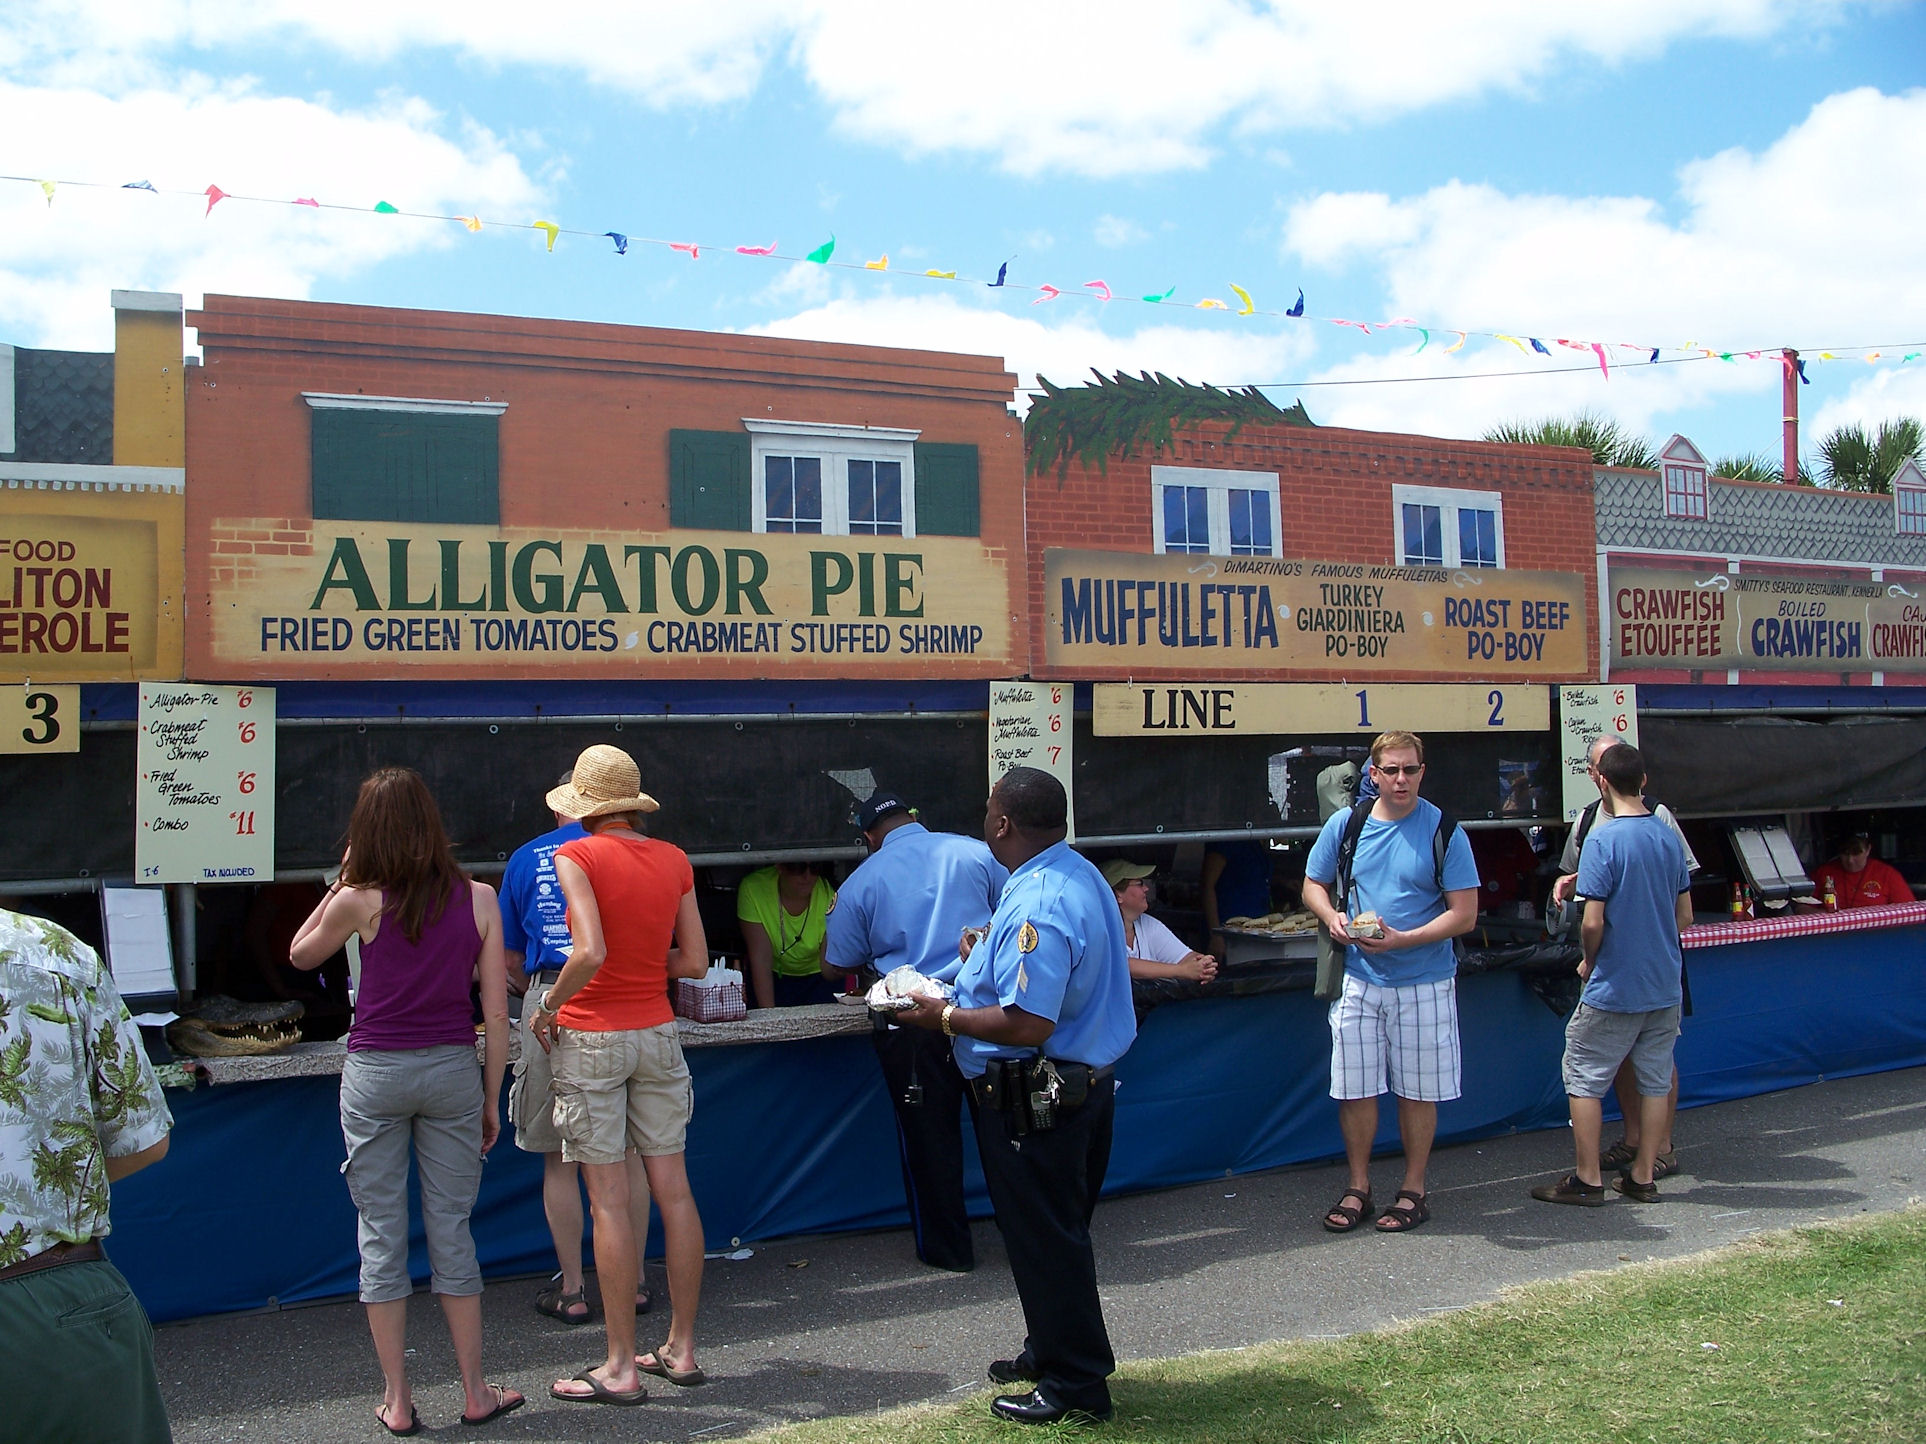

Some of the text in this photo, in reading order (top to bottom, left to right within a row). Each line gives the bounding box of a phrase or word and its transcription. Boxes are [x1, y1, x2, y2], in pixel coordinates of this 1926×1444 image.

[308, 537, 924, 618] ALLIGATOR PIE
[1311, 564, 1363, 579] FAMOUS
[1368, 567, 1448, 583] MUFFULETTAS
[1320, 583, 1384, 608] TURKEY
[1771, 581, 1805, 594] SEAFOOD
[1061, 577, 1279, 649] MUFFULETTA
[1444, 597, 1570, 630] ROAST BEEF
[1616, 588, 1725, 621] CRAWFISH
[1778, 600, 1826, 617] BOILED
[0, 612, 130, 653] EROLE
[1296, 607, 1405, 634] GIARDINIERA
[261, 617, 983, 654] FRIED GREEN TOMATOES CRABMEAT STUFFED SHRIMP
[1325, 634, 1389, 658] PO-BOY
[1467, 631, 1545, 662] PO-BOY
[1751, 618, 1861, 658] CRAWFISH
[1873, 623, 1926, 657] CRAWFI
[200, 692, 219, 705] Pie
[1142, 689, 1505, 728] LINE 1 2
[22, 692, 60, 744] 3
[150, 719, 207, 735] Crabmeat
[156, 732, 199, 748] Stuffed
[167, 746, 209, 762] Shrimp
[994, 748, 1014, 760] Roast
[150, 768, 177, 783] Fried
[158, 780, 194, 796] Green
[168, 792, 221, 806] Tomatoes
[152, 817, 189, 832] Combo
[203, 868, 217, 878] TAX
